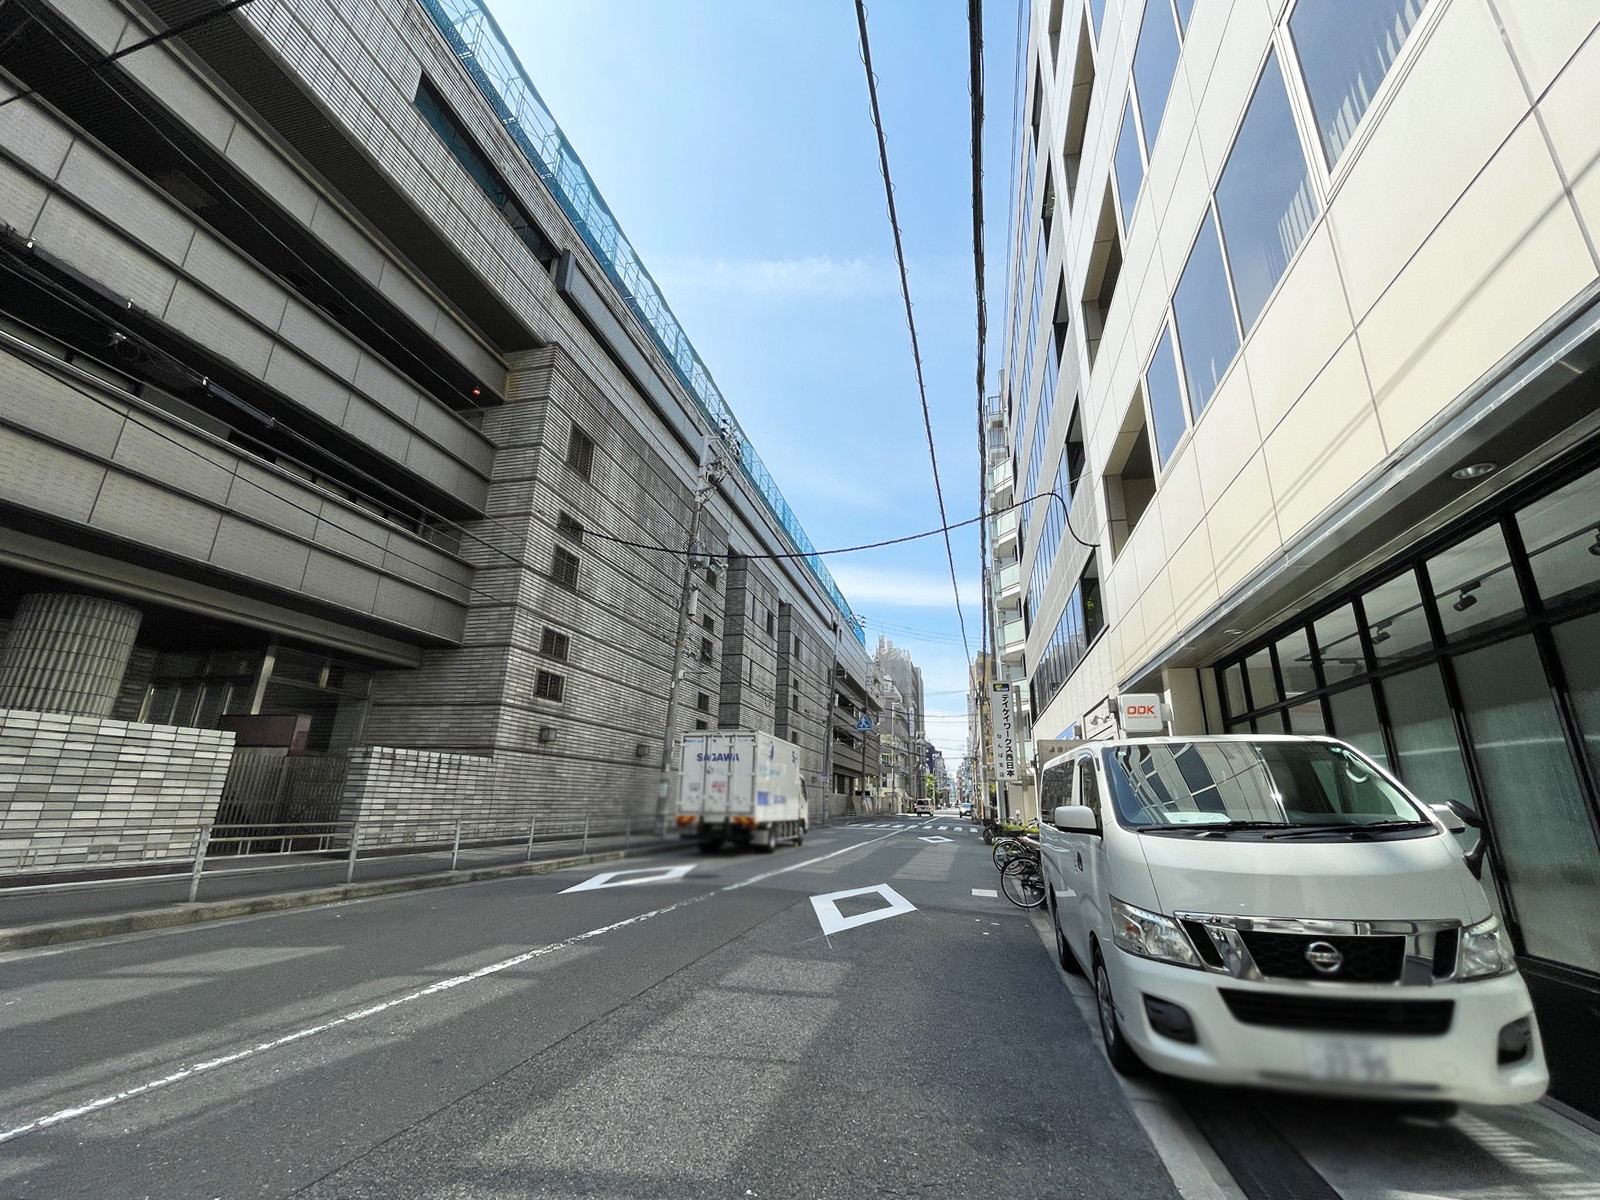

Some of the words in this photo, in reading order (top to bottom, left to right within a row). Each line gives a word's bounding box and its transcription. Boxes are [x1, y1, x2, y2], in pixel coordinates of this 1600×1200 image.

[1126, 705, 1156, 715] ODK
[1002, 694, 1015, 778] テイケイワークス西日本
[696, 753, 739, 762] SAGAWA
